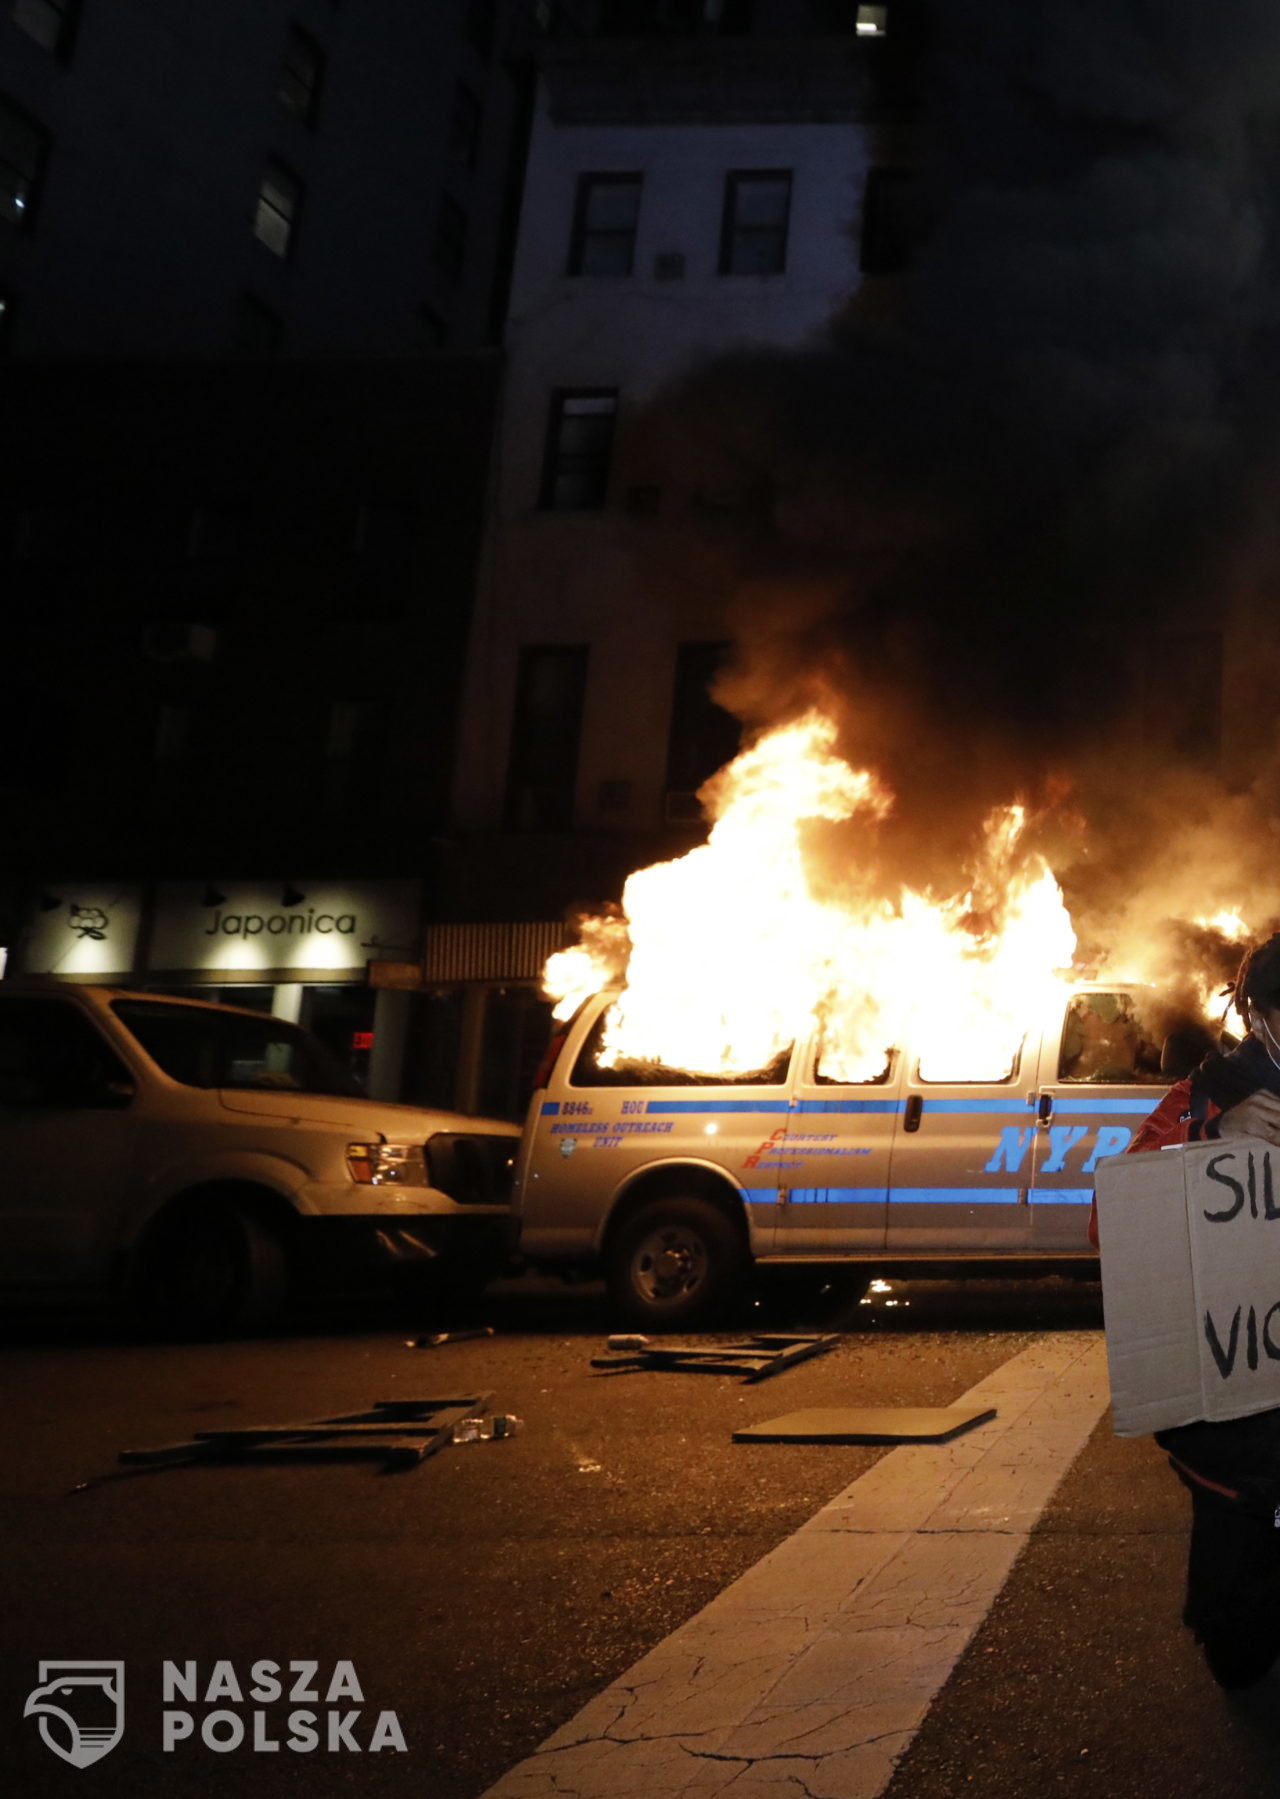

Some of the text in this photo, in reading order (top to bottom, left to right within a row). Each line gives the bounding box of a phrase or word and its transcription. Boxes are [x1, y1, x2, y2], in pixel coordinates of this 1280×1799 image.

[205, 908, 356, 940] Japonica
[550, 1122, 674, 1134] HOMELESS OUTREACH
[593, 1136, 623, 1148] UNIT
[984, 1126, 1132, 1172] NYP
